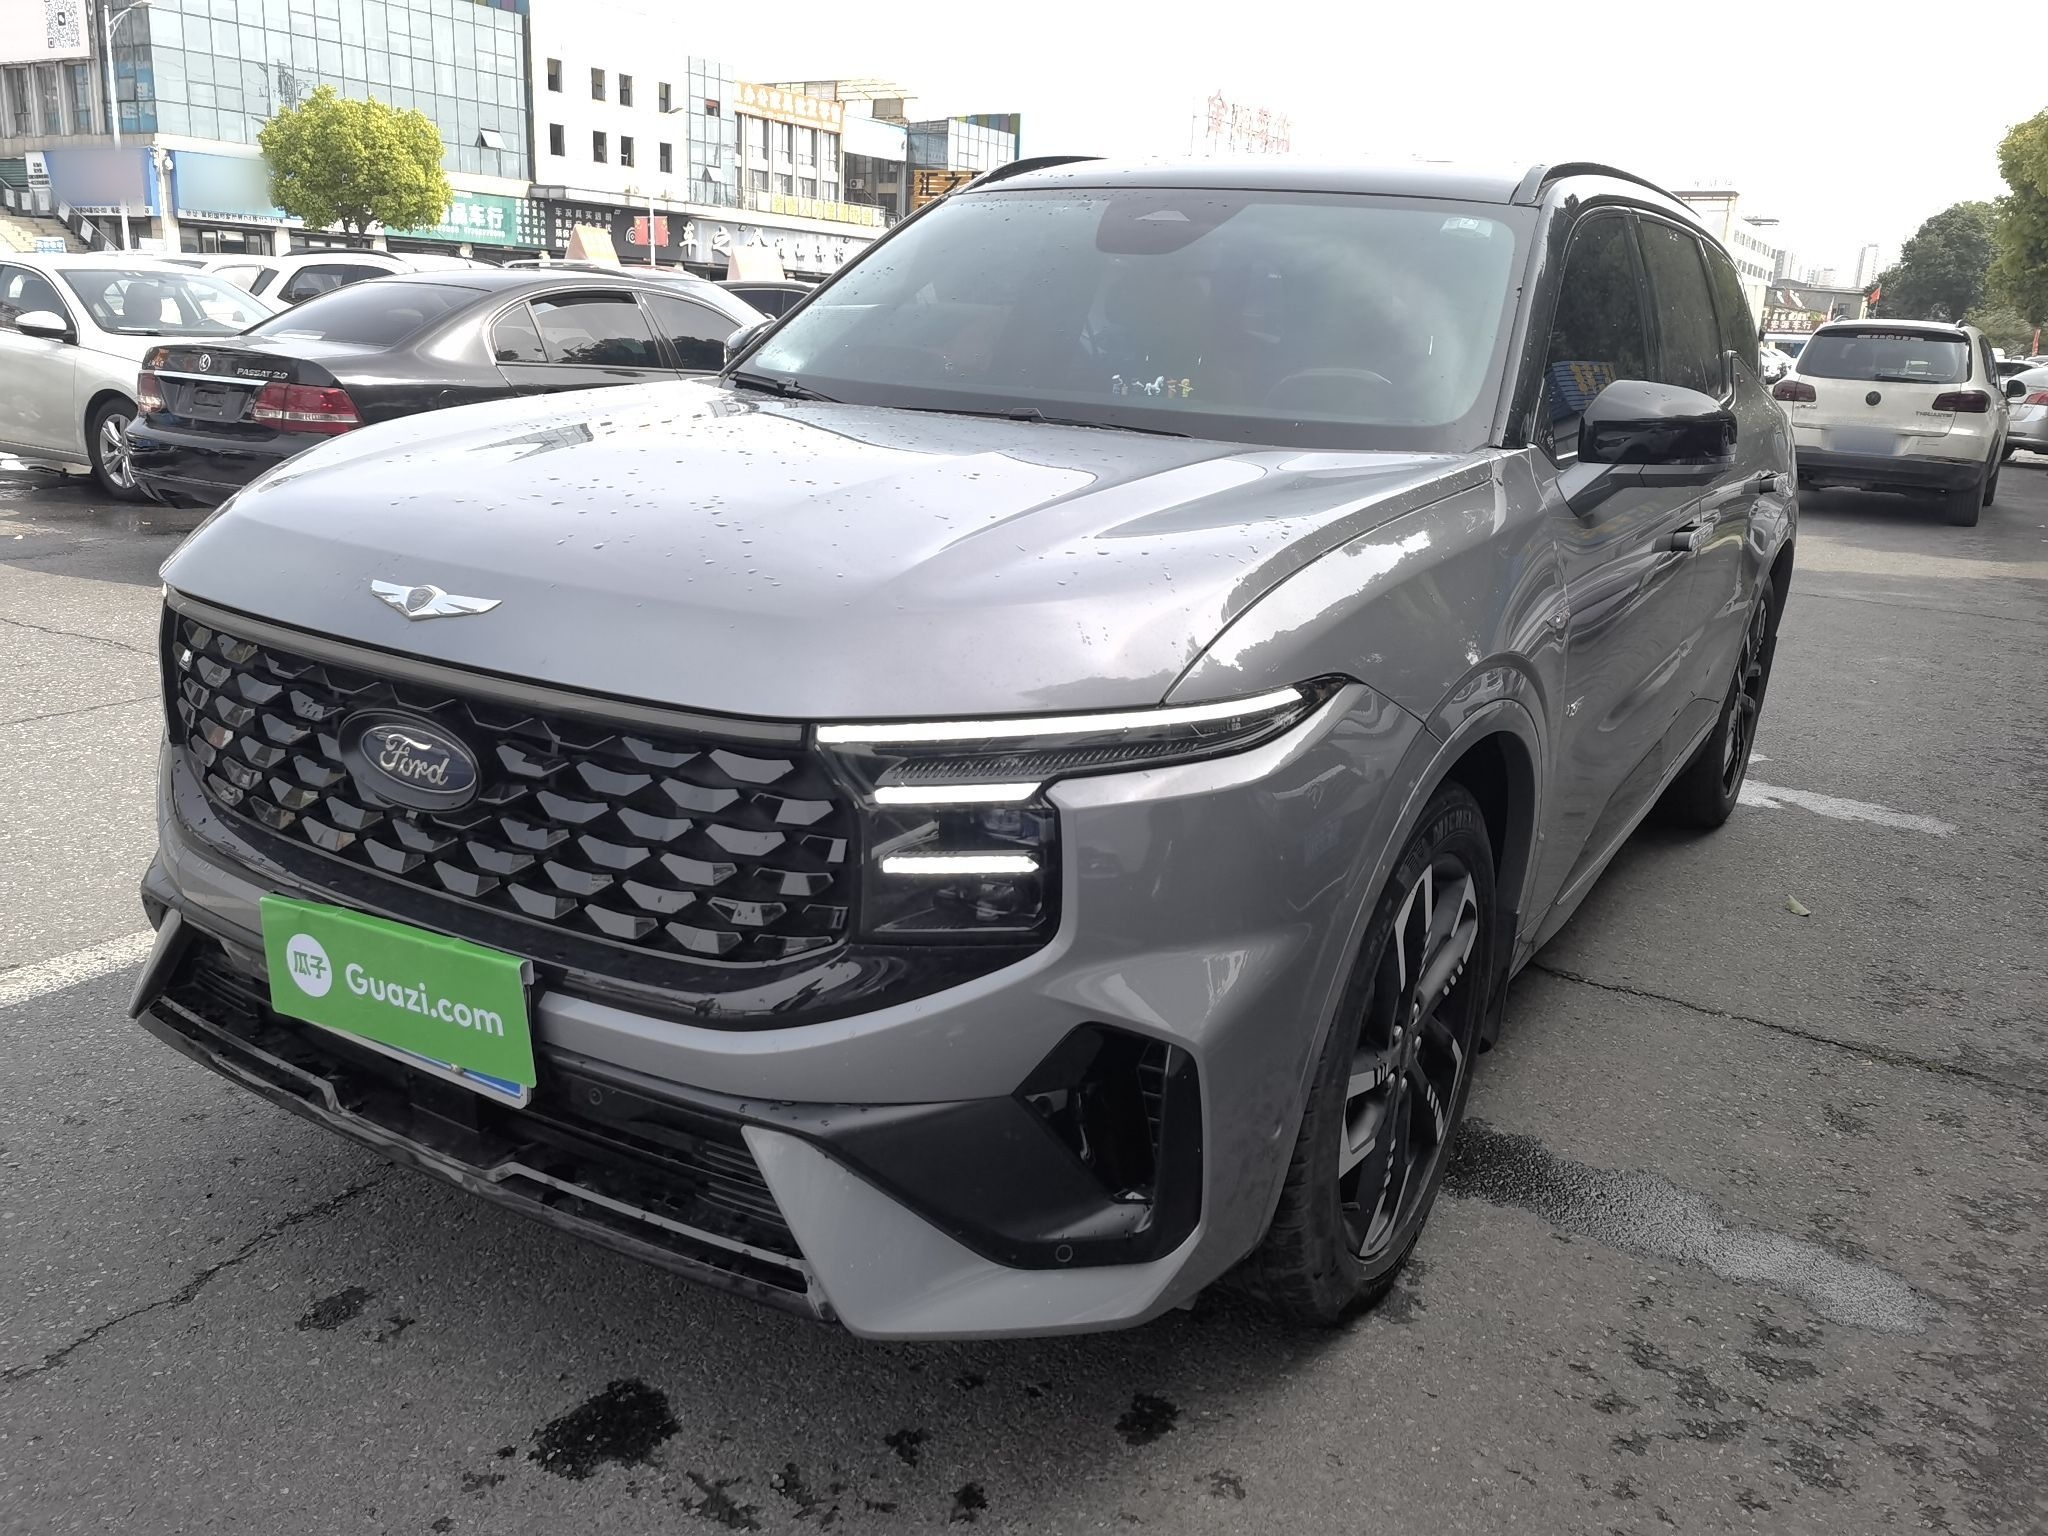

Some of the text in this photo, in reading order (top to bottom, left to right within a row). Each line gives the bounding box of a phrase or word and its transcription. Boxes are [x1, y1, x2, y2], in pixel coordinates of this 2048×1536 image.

[919, 171, 987, 196] 汇之
[237, 367, 289, 379] PASSAT 2.0
[380, 733, 450, 786] Ford
[292, 950, 328, 980] 瓜子
[345, 962, 505, 1037] Guazi.com
